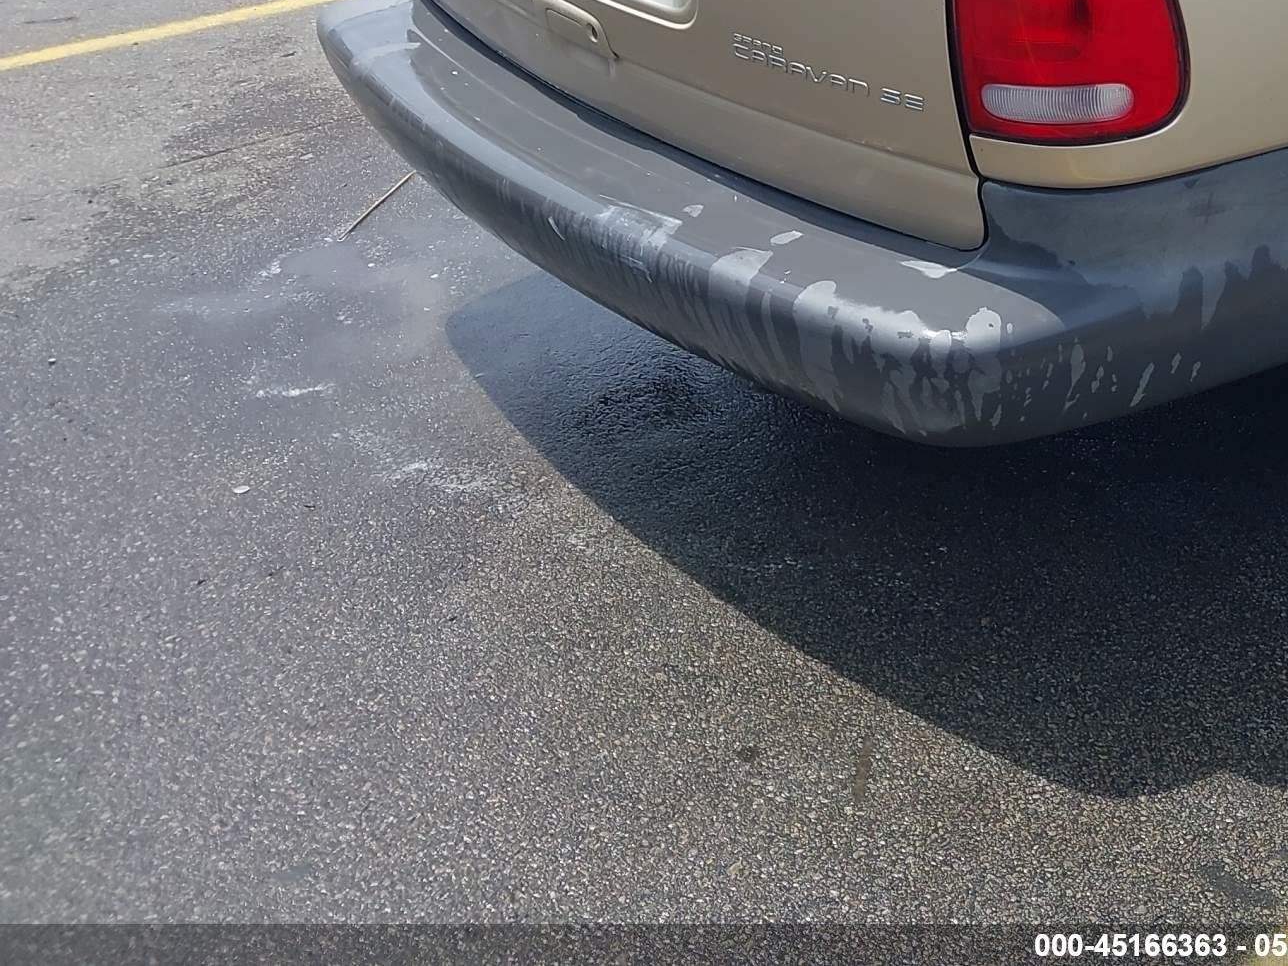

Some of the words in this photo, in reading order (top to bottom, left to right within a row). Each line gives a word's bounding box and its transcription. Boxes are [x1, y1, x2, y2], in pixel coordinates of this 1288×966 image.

[733, 33, 784, 54] GRAND
[732, 43, 871, 98] CARAVAN
[880, 87, 925, 112] SE
